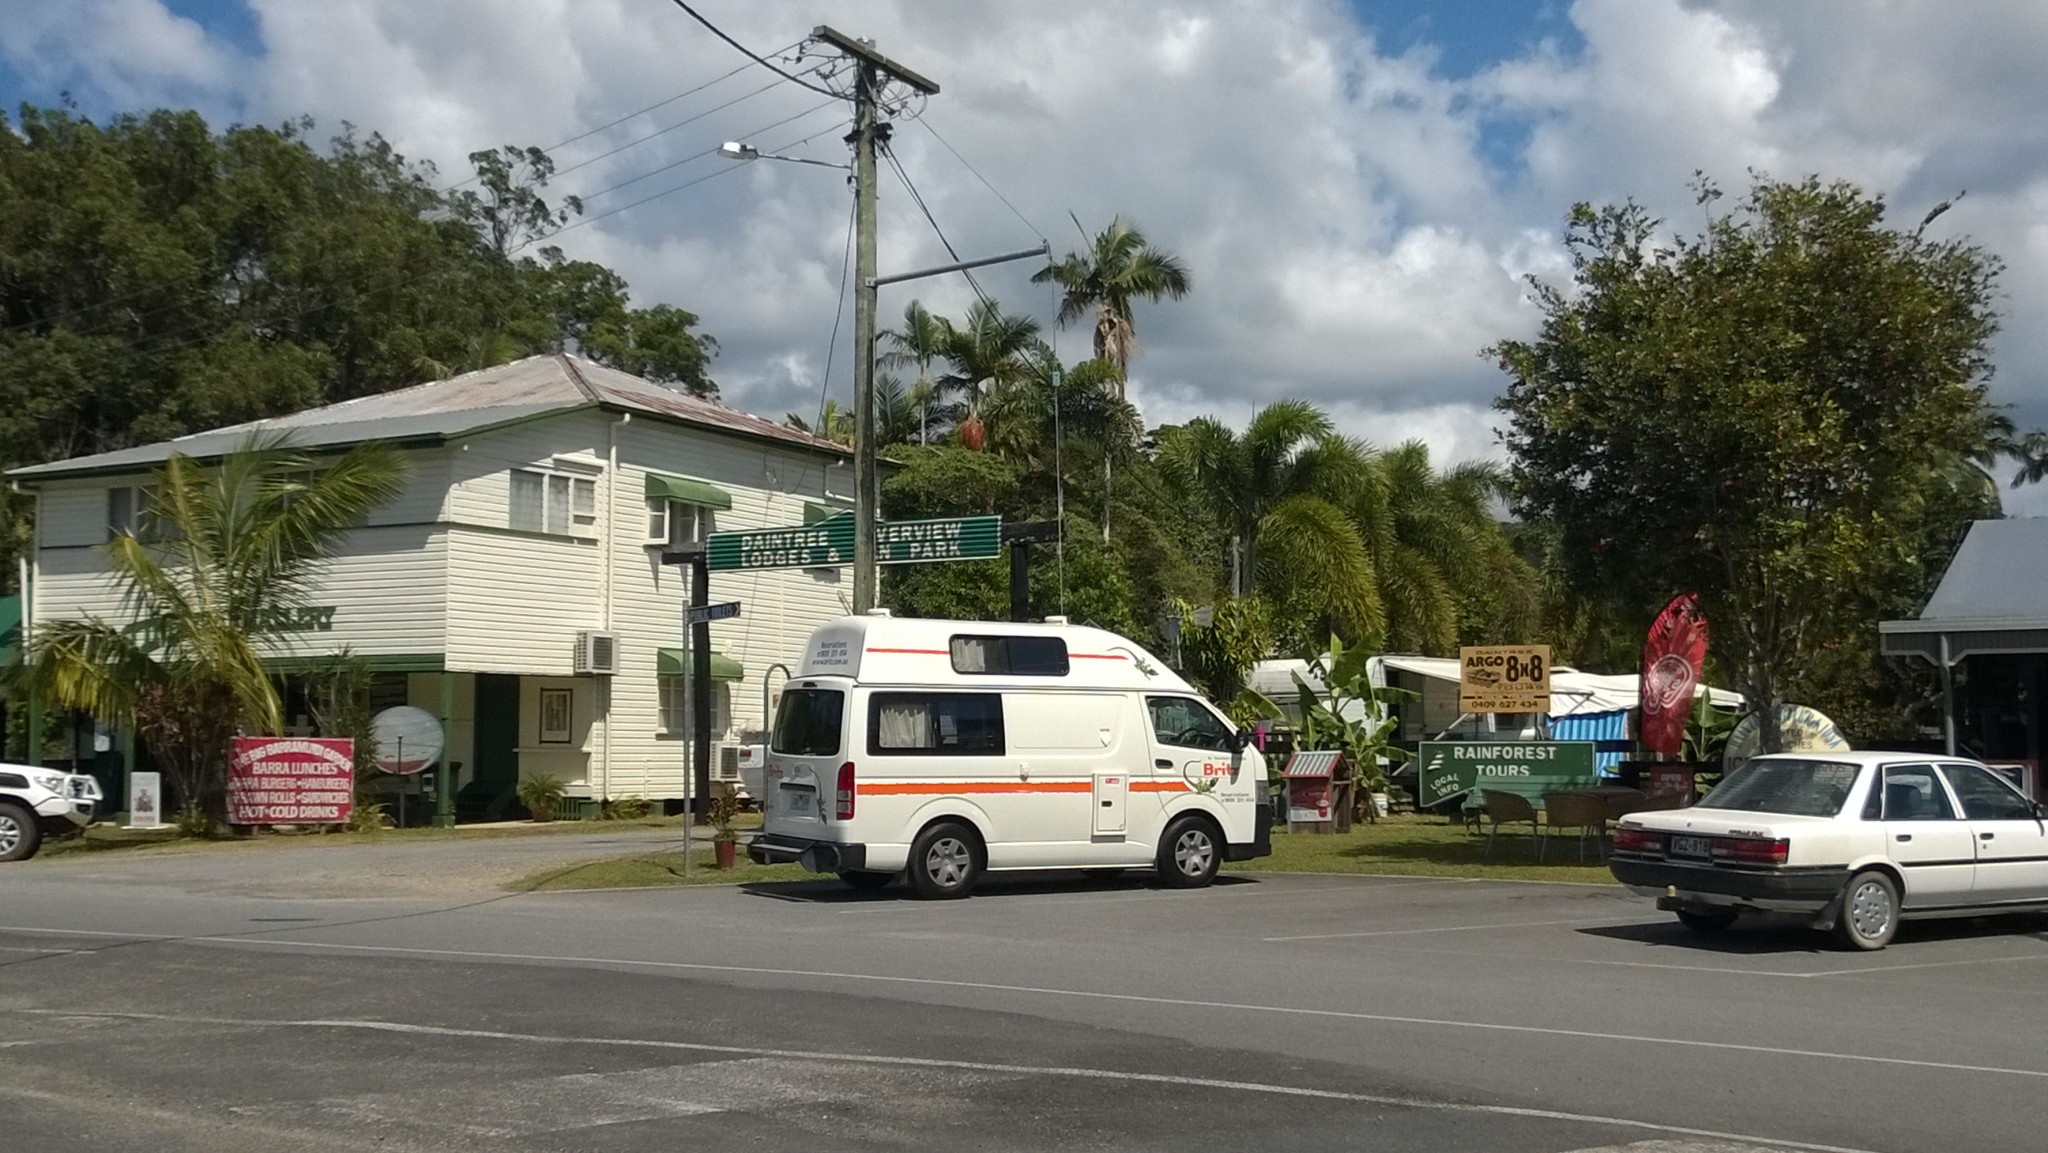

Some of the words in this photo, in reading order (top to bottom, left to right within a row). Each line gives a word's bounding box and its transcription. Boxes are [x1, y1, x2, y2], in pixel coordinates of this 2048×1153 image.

[741, 531, 829, 550] DAINTREE
[876, 523, 962, 543] VERVIEW
[741, 549, 811, 567] LODGES
[827, 548, 840, 562] &
[910, 541, 961, 558] PARK
[1466, 656, 1504, 667] ARGO
[1472, 700, 1496, 709] 0409
[1499, 700, 1517, 708] 627
[1519, 700, 1539, 708] 434
[1453, 746, 1557, 760] RAINFOREST
[253, 762, 289, 775] BARRA
[291, 762, 338, 775] LUNCHES
[1475, 765, 1531, 777] TOURS
[1430, 773, 1460, 791] LOCAL
[1437, 783, 1460, 797] INFO
[269, 791, 296, 804] ROLLS
[239, 806, 266, 818] HOT
[269, 806, 298, 818] COLD
[299, 806, 339, 818] DRINKS
